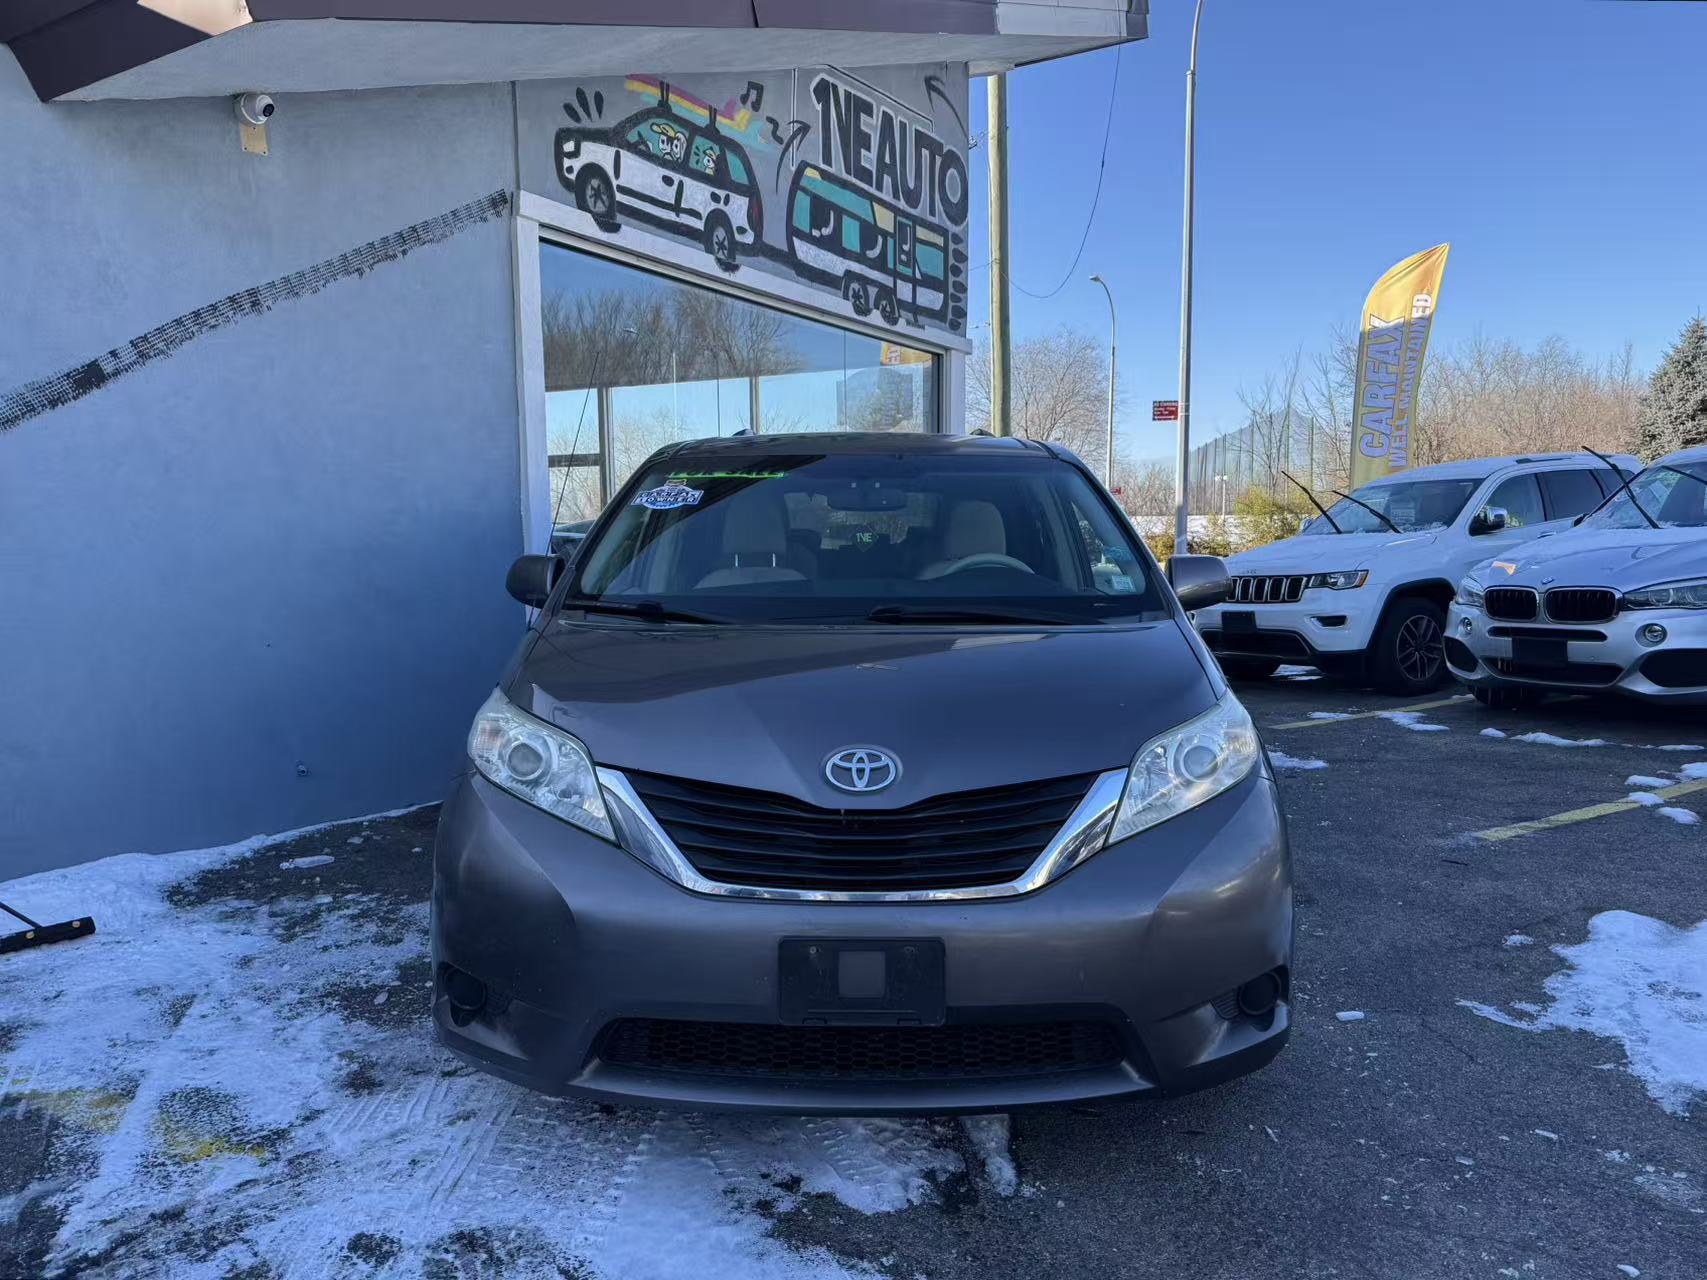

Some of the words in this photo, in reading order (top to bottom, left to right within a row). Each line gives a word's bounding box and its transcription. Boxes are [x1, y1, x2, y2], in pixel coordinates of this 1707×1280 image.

[1359, 313, 1405, 458] CARFAX
[1390, 416, 1408, 468] WELL
[1399, 294, 1432, 410] MAINTAINED
